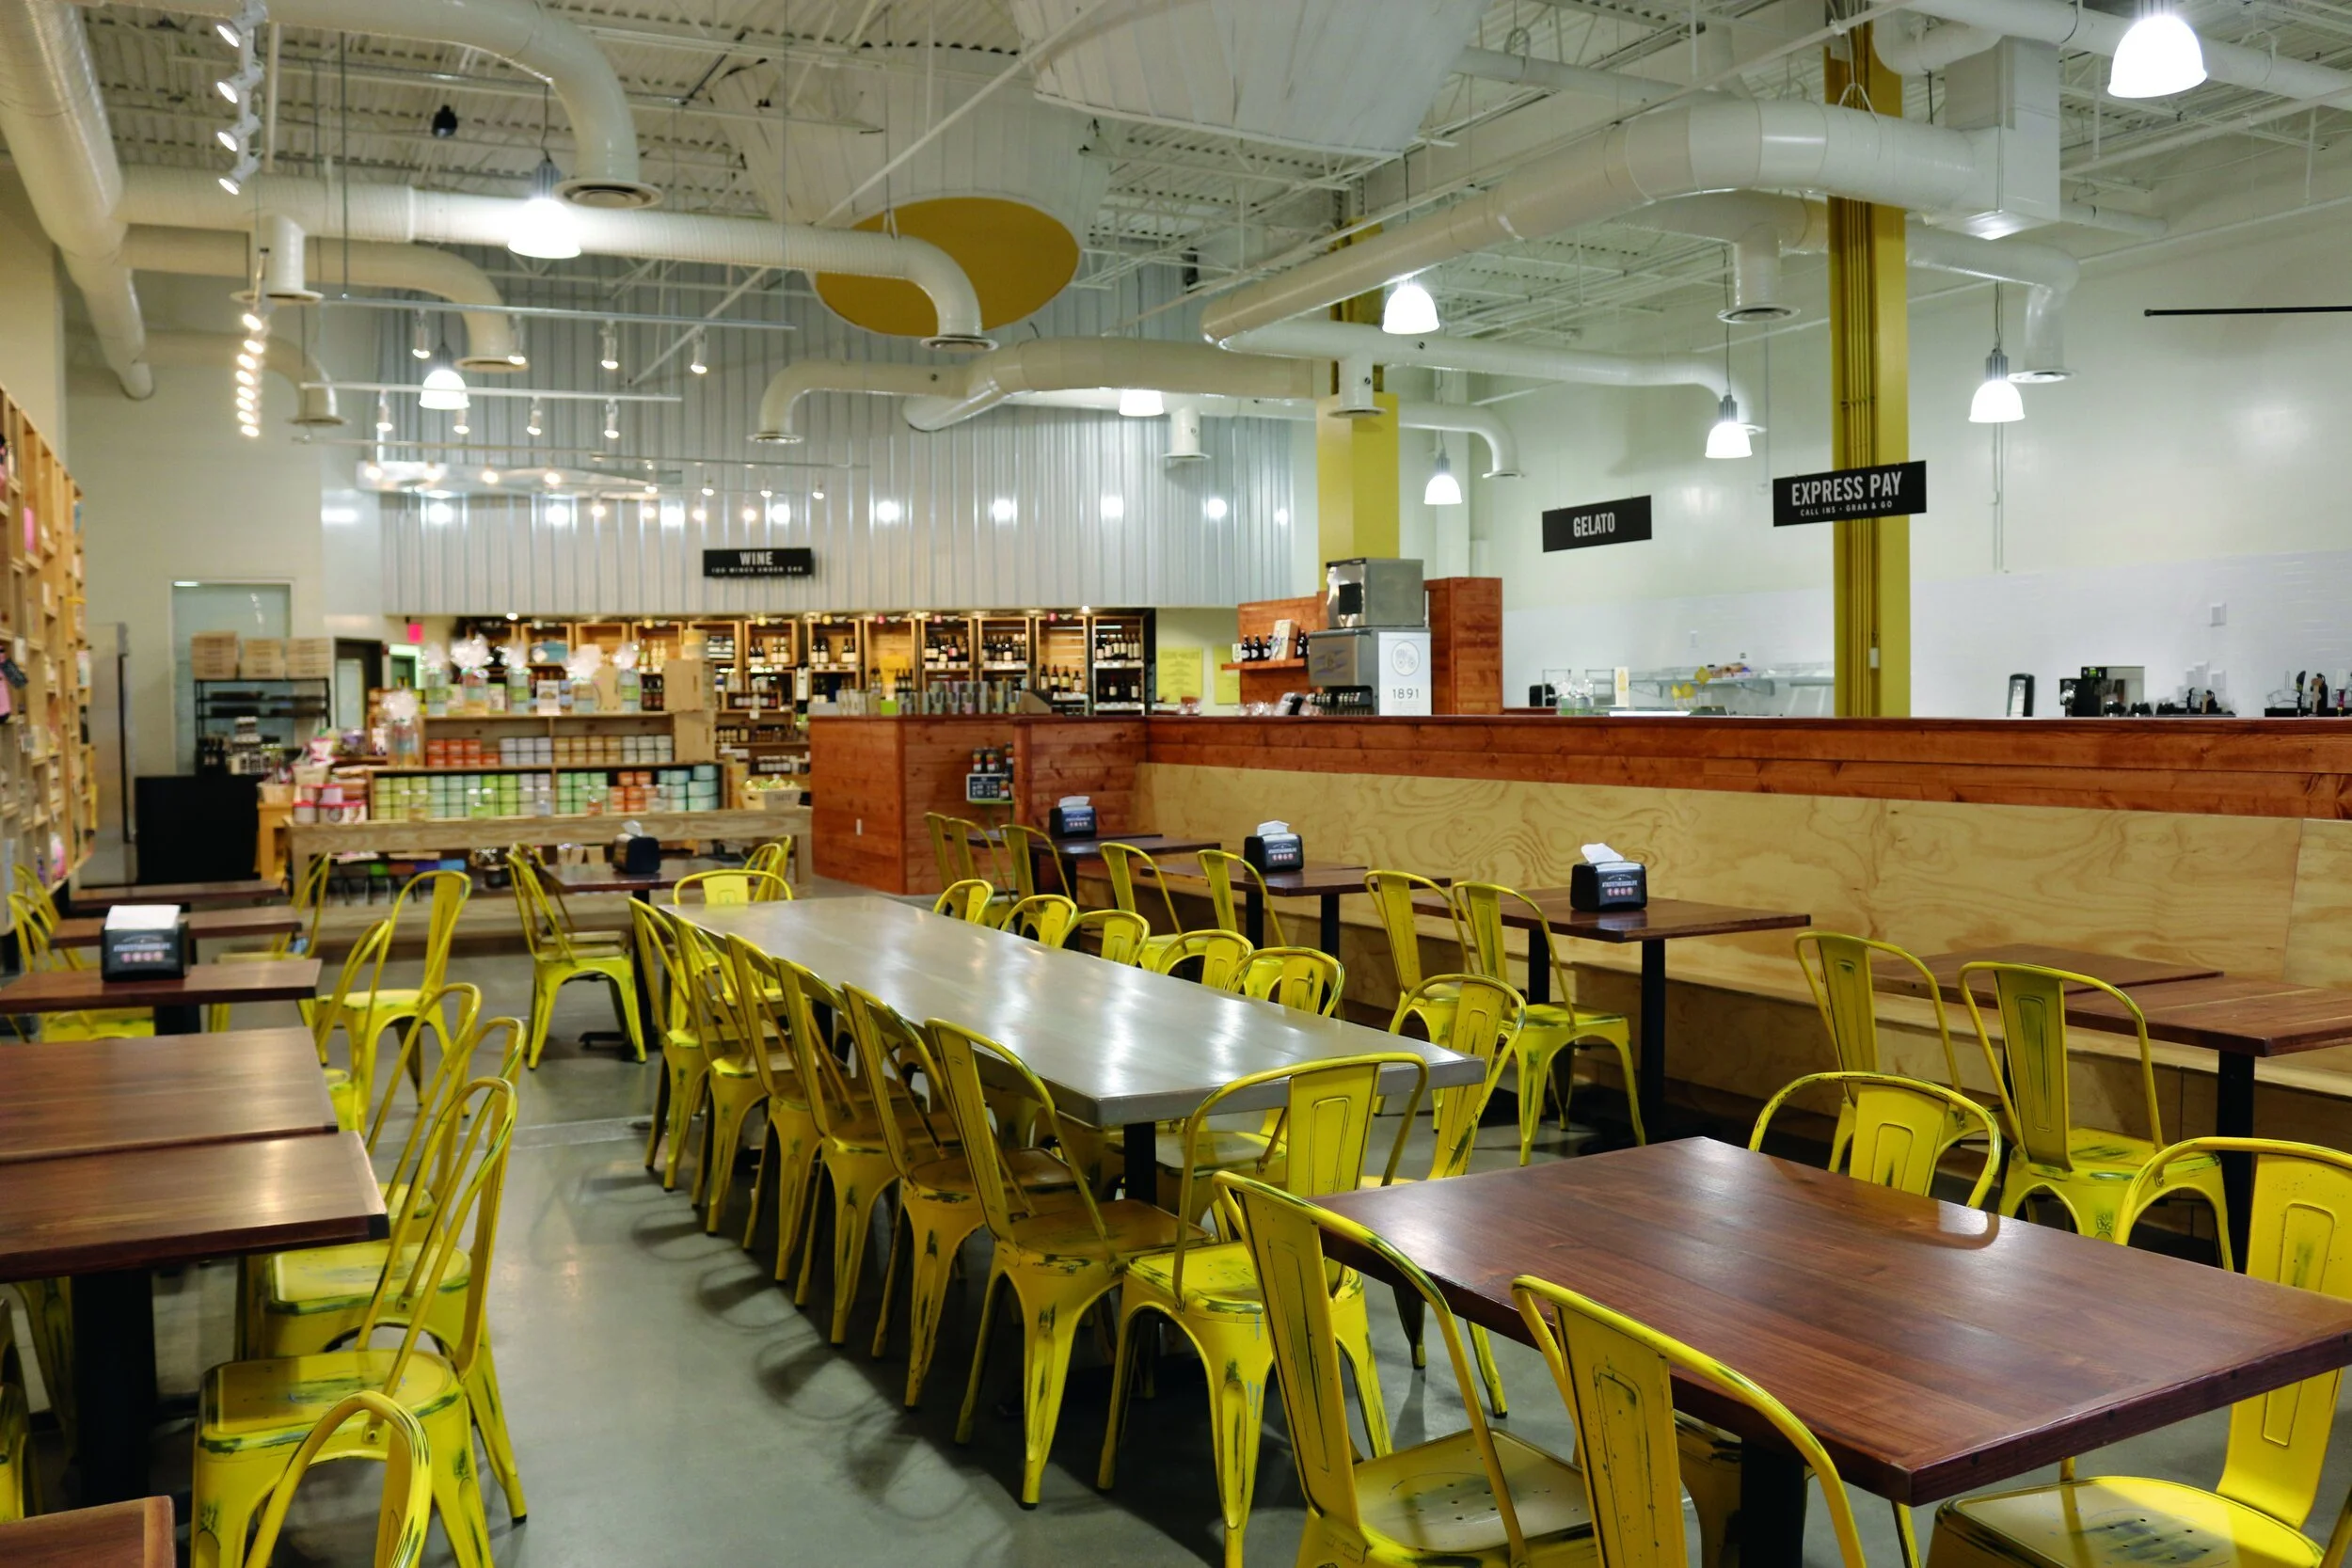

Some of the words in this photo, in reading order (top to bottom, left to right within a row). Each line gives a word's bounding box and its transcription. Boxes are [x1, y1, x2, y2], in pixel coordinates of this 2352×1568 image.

[1791, 476, 1864, 506] EXPRESS
[1869, 471, 1902, 498] PAY
[1800, 507, 1820, 516] CALL
[1822, 505, 1836, 514] INS
[1846, 502, 1867, 512] GRAB
[1573, 512, 1615, 537] GELATO
[739, 551, 773, 565] WINE
[1392, 689, 1420, 699] 1891
